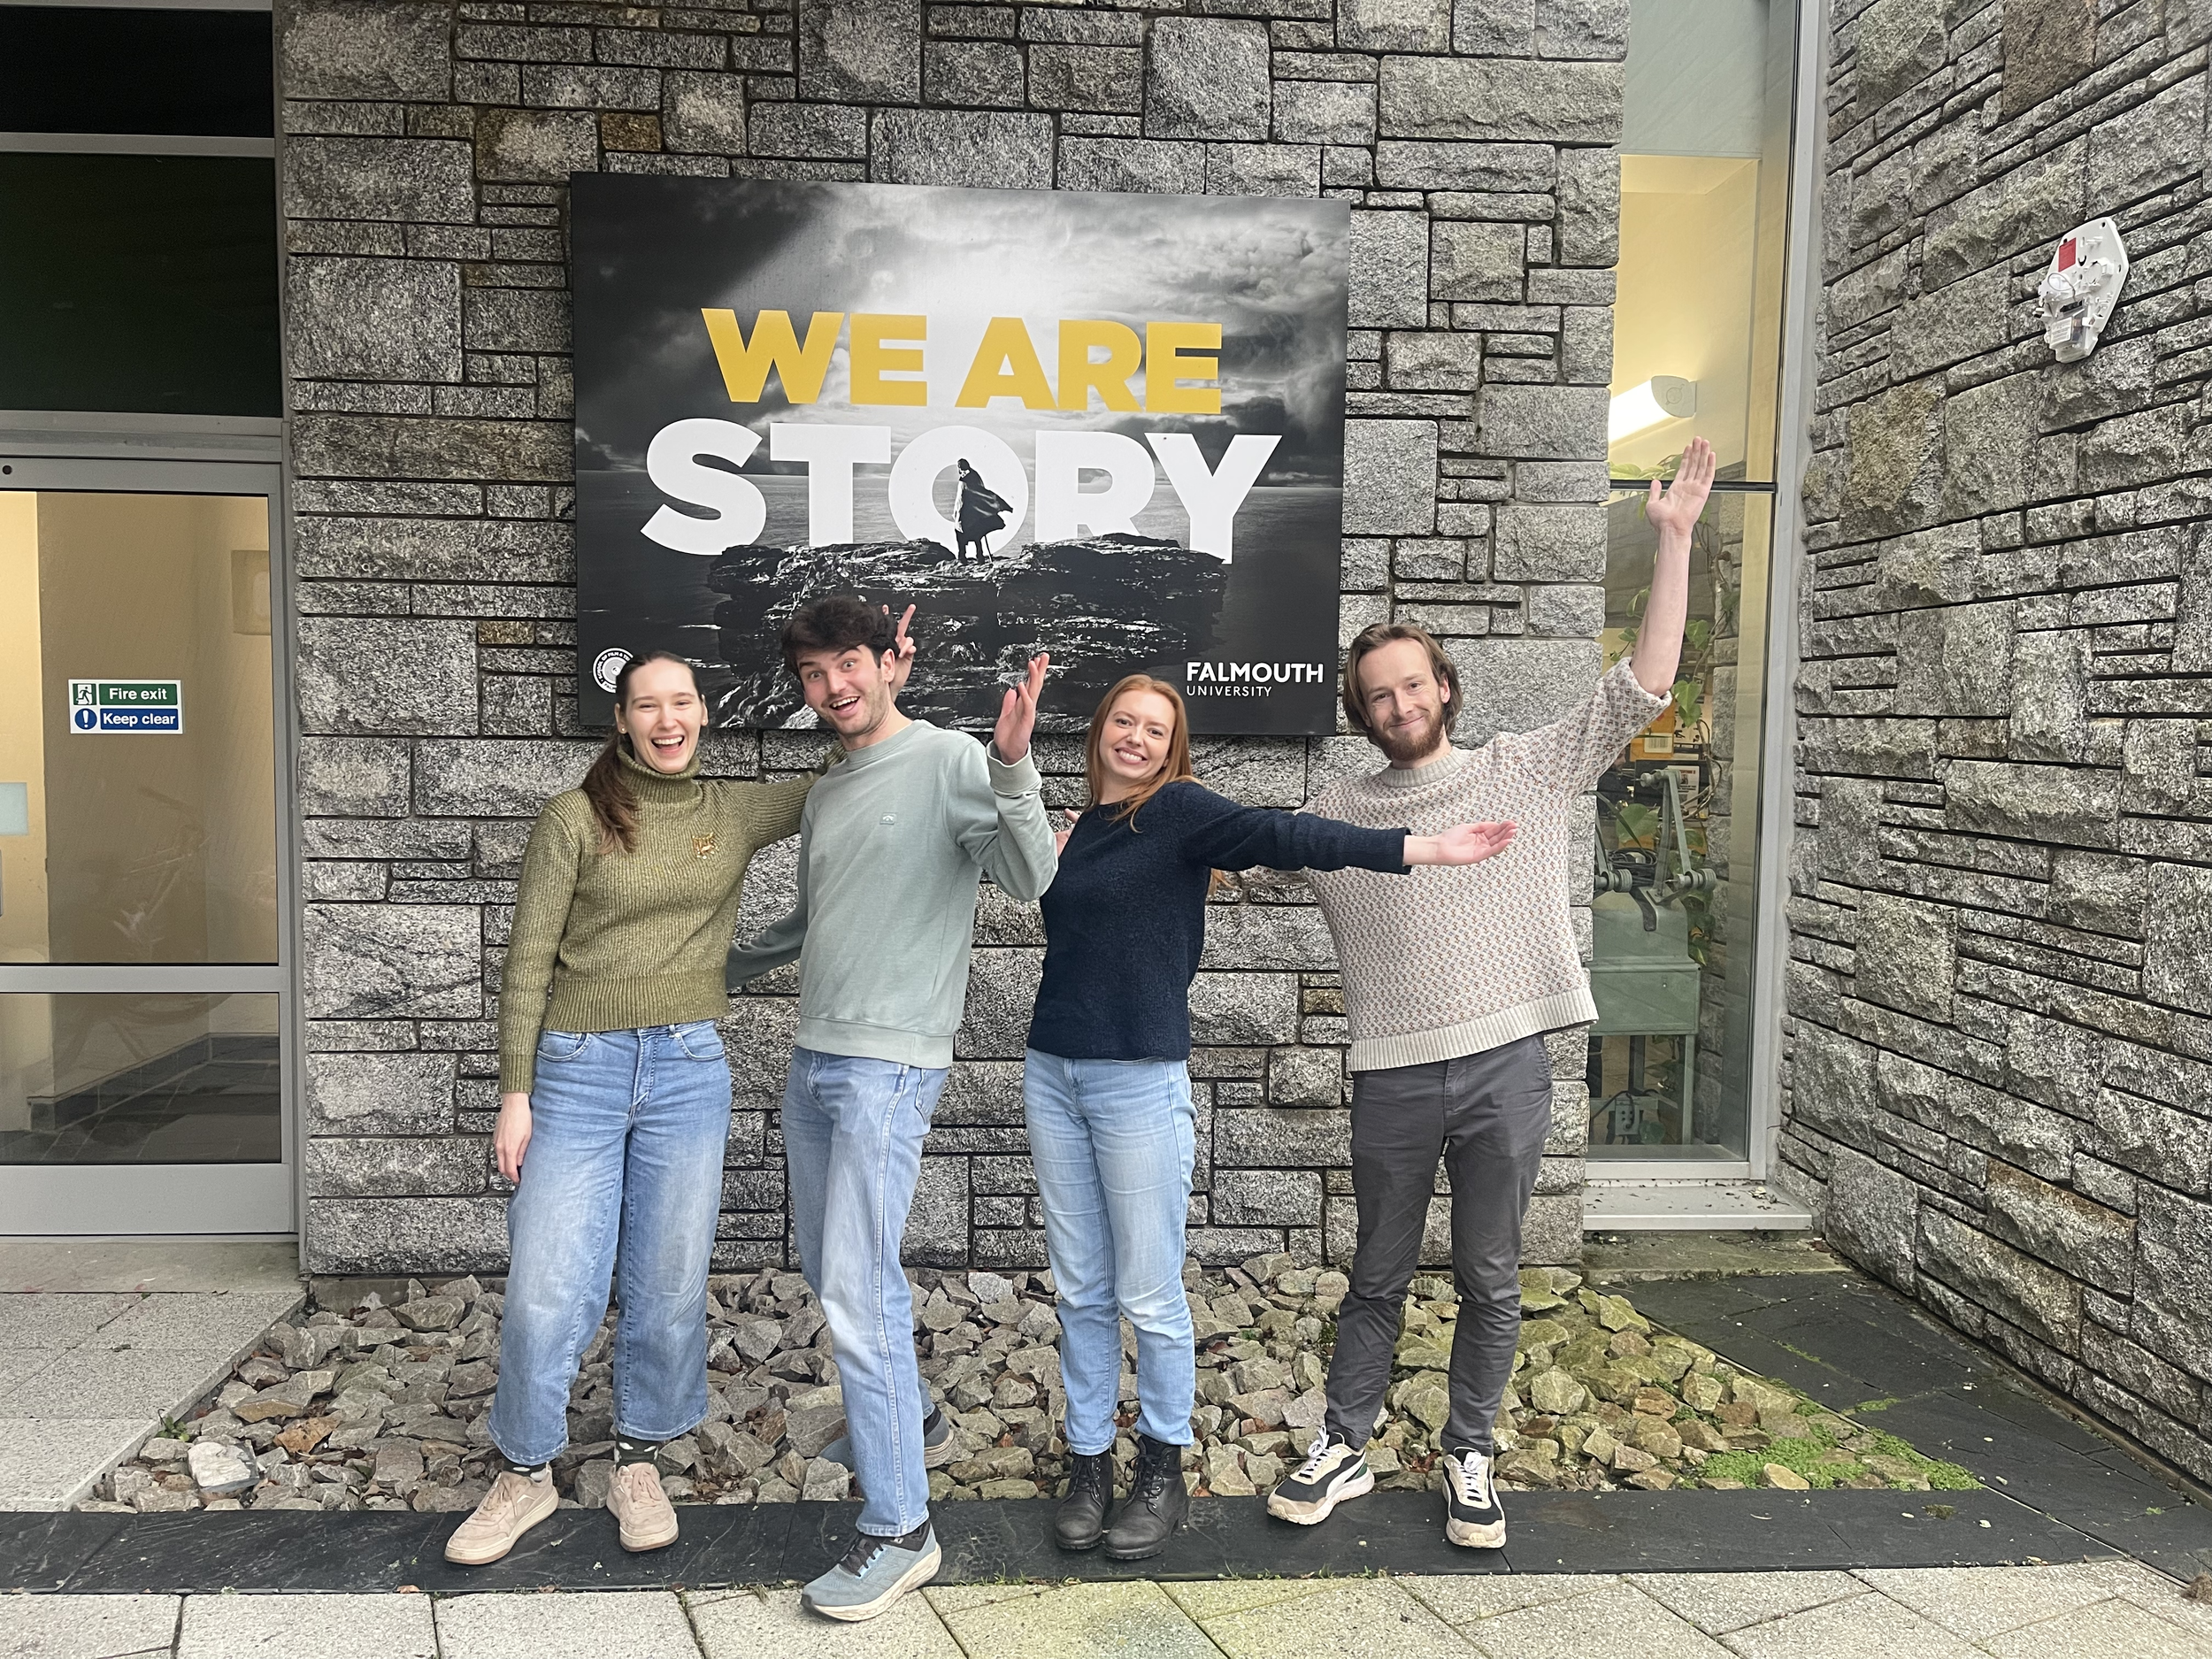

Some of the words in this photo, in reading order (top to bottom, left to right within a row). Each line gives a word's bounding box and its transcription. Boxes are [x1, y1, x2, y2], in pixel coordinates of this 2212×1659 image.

[701, 308, 928, 407] WE
[954, 317, 1222, 414] ARE
[641, 418, 1282, 565] STORY
[1187, 662, 1324, 683] FALMOUTH
[109, 687, 137, 700] Fire
[141, 688, 167, 700] exit
[1187, 685, 1272, 697] UNIVERSITY
[103, 712, 138, 727] Keep
[142, 713, 176, 725] clear
